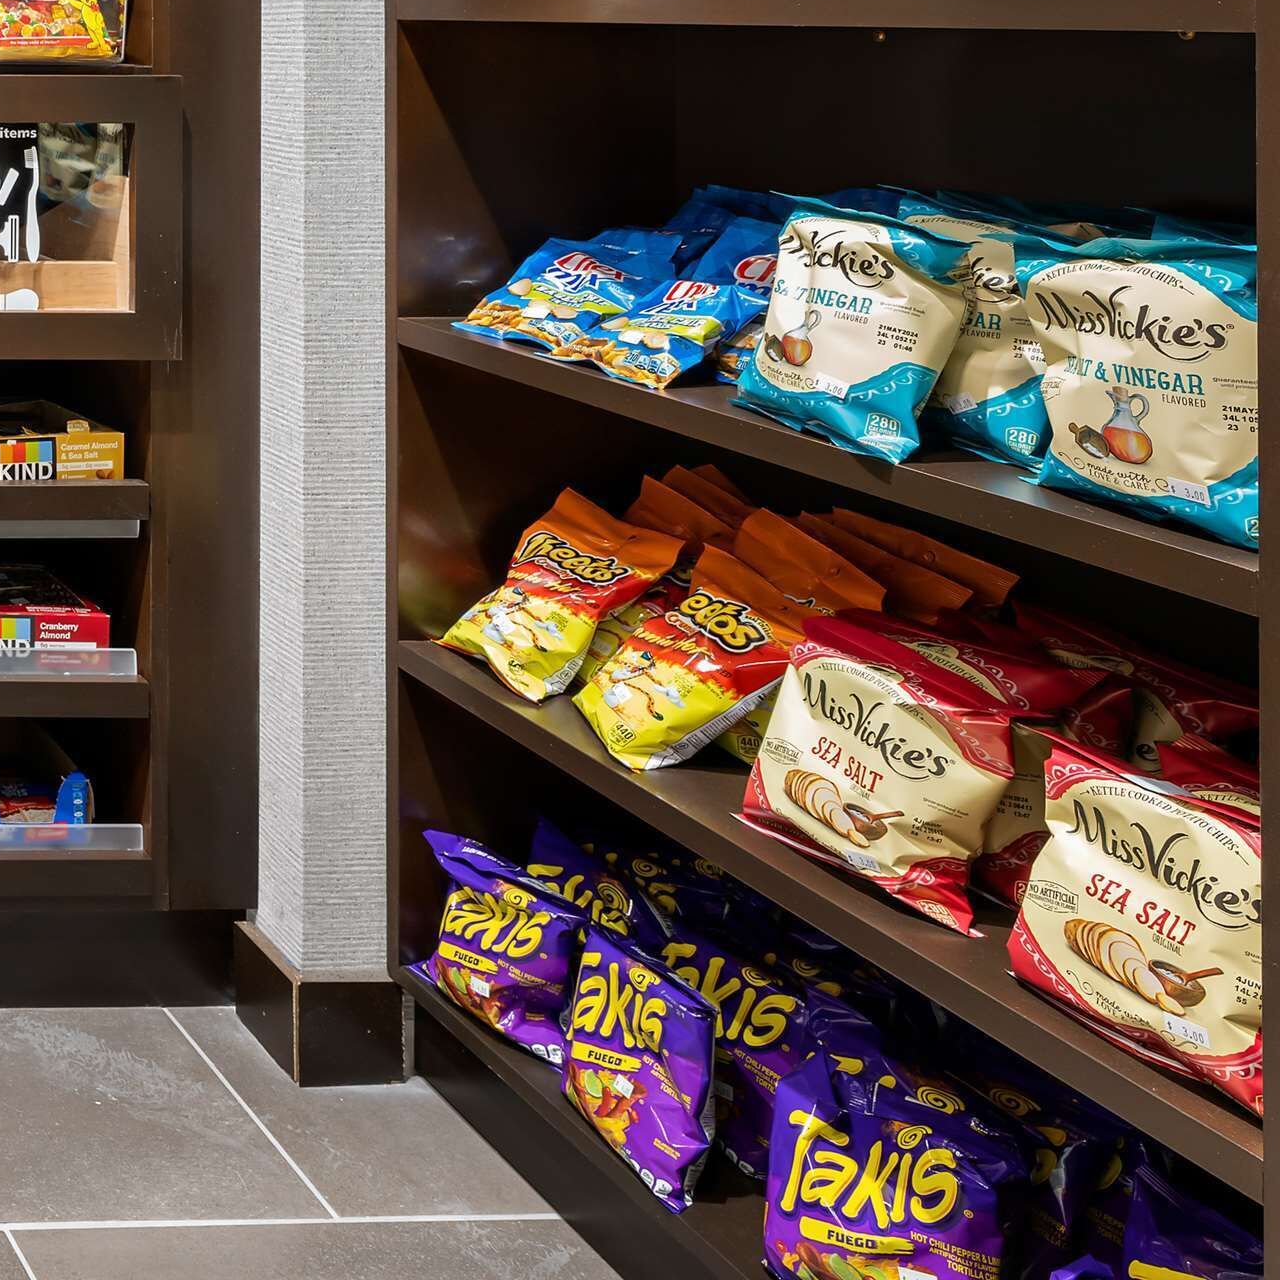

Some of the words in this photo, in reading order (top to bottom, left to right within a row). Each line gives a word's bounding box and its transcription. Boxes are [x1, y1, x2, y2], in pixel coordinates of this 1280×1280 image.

[0, 127, 37, 138] items
[833, 311, 870, 325] FLAVORED
[1034, 291, 1105, 336] Miss
[1083, 285, 1229, 362] Vickie's
[878, 323, 919, 339] 21MAY2024
[1161, 392, 1207, 408] FLAVORED
[870, 414, 898, 431] 280
[60, 442, 87, 451] Caramel
[88, 441, 119, 451] Almond
[1008, 429, 1038, 446] 280
[39, 622, 80, 633] Cranberry
[40, 631, 72, 640] Almond
[803, 671, 855, 731] Miss
[849, 693, 950, 780] Vickie's
[811, 736, 842, 770] SEA
[843, 756, 884, 795] SALT
[1084, 873, 1131, 916] SEA
[1135, 899, 1197, 947] SALT
[1151, 932, 1183, 957] ORIGINAL
[452, 948, 483, 968] FUEGO
[565, 950, 670, 1056] Takis
[586, 1049, 625, 1068] FUEGO
[779, 1106, 963, 1233] Takis
[825, 1228, 877, 1251] FUEGO
[928, 1247, 974, 1267] ARTIFICIALLY
[946, 1259, 984, 1280] TORTILLA
